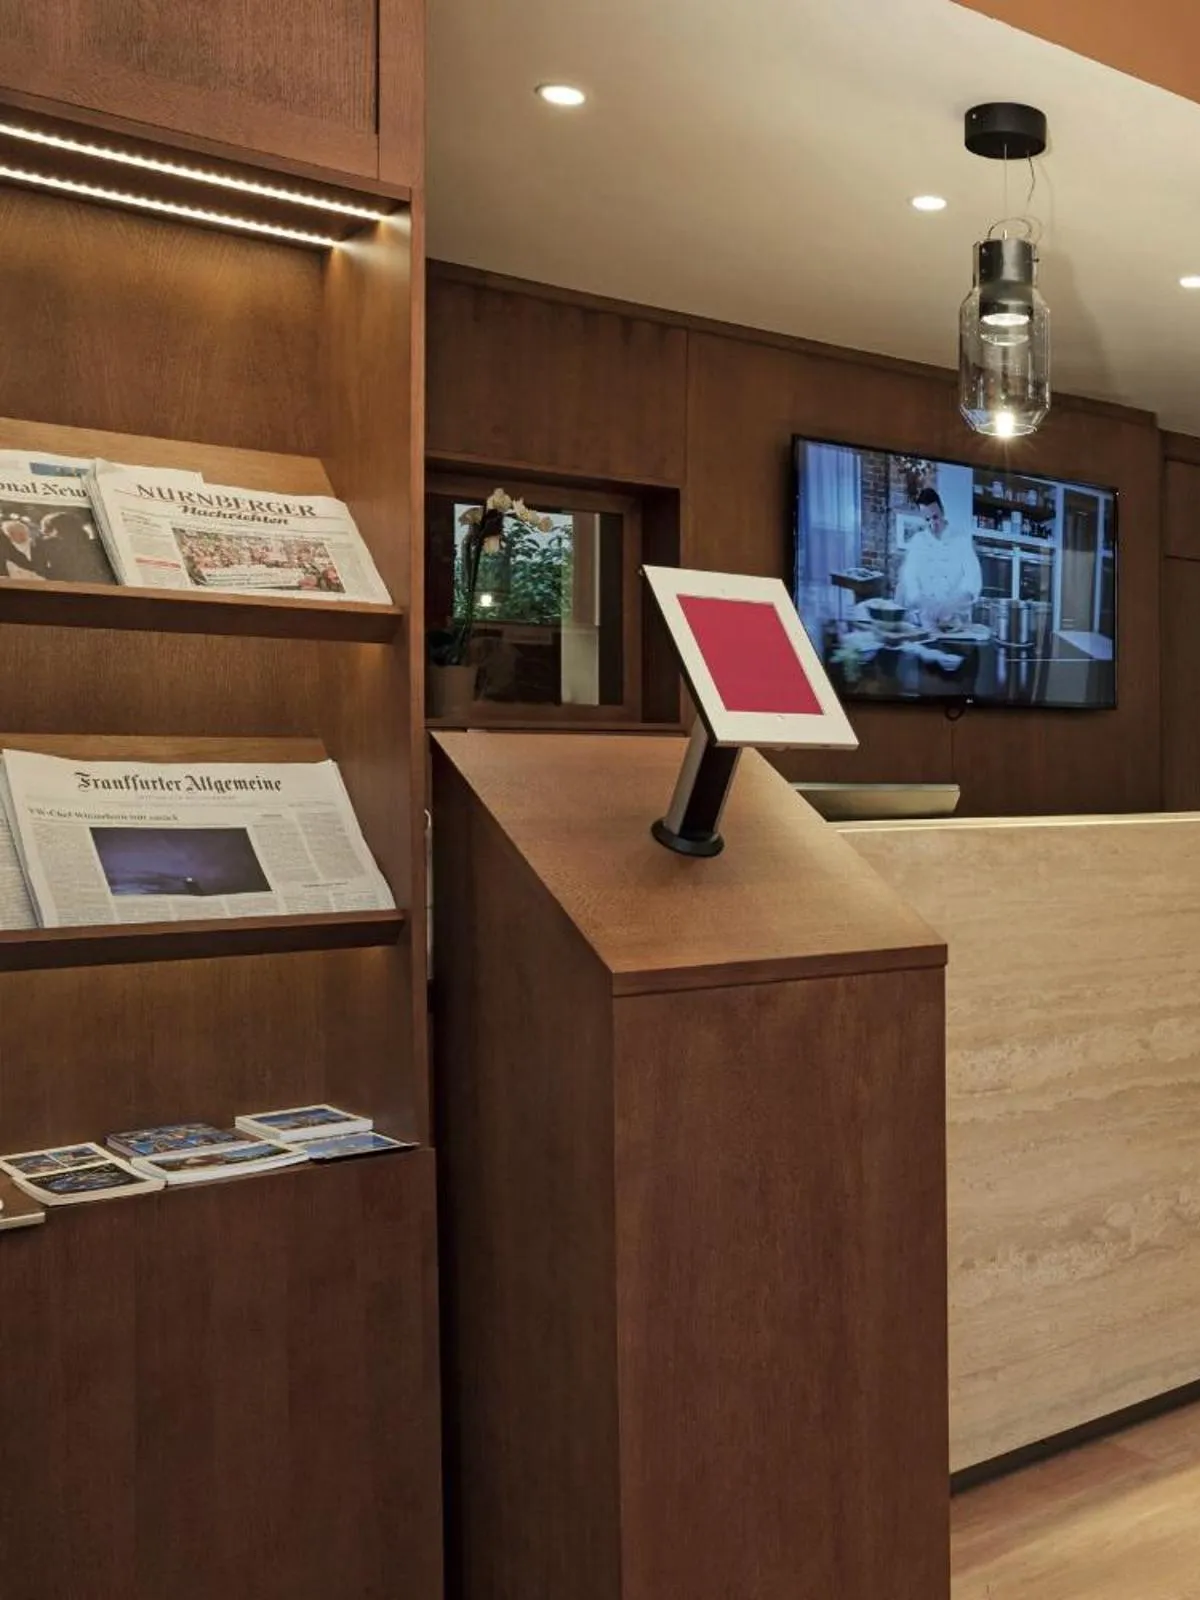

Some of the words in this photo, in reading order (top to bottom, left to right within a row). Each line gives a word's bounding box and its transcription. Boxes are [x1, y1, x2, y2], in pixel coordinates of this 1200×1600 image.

[177, 504, 289, 526] Nachrichten
[74, 771, 182, 793] Frankfurter
[183, 774, 282, 794] Allgemeine
